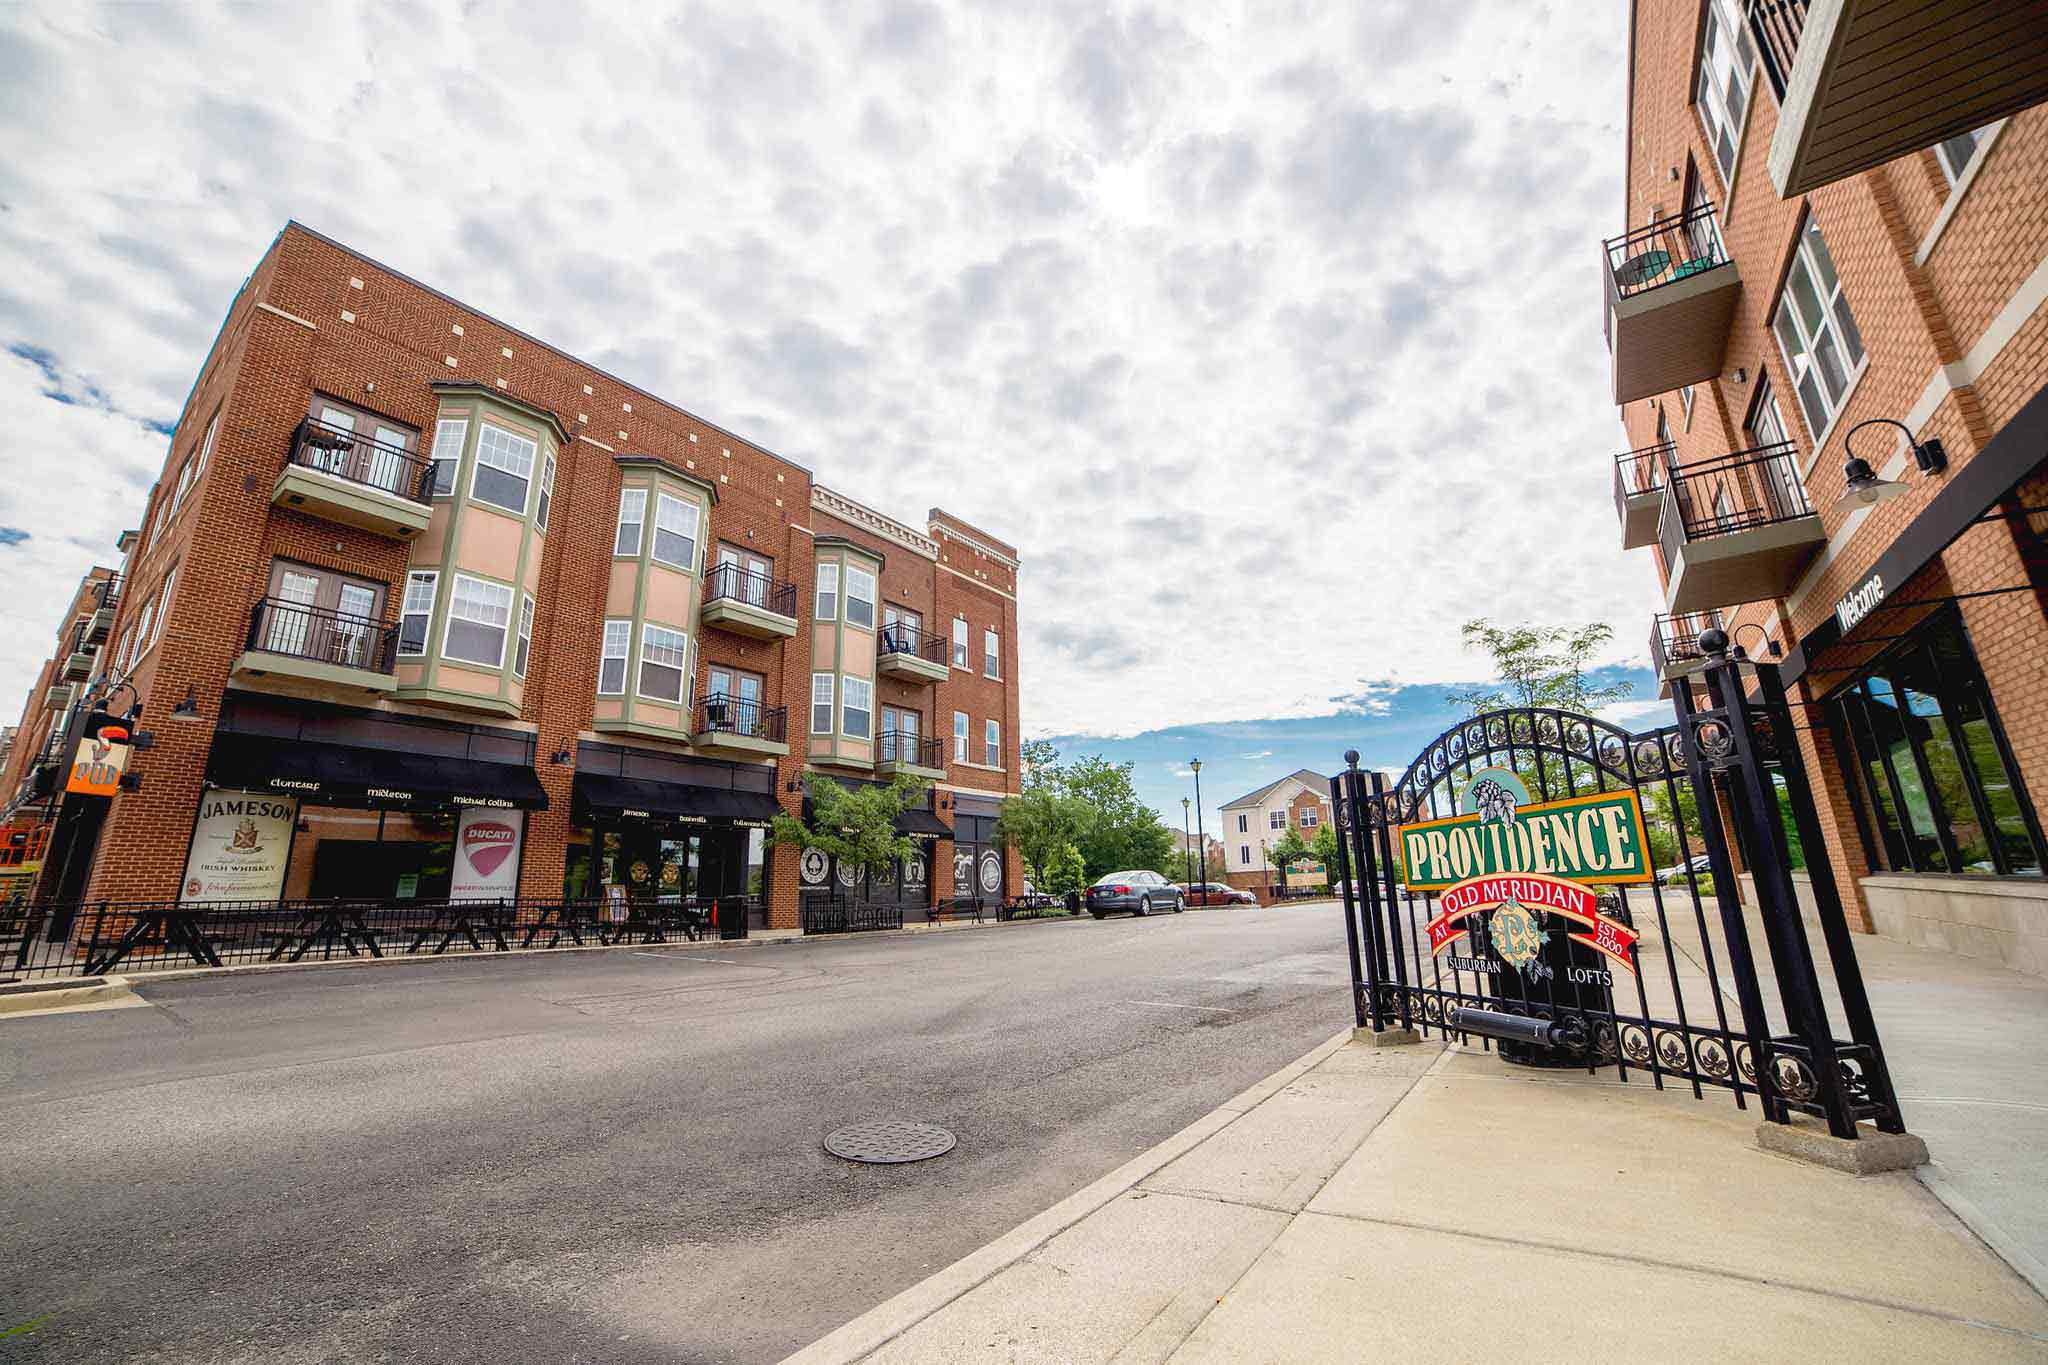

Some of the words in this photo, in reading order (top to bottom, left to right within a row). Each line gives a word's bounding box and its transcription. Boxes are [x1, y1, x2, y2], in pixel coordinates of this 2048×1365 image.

[1836, 574, 1884, 631] Welcome
[76, 762, 118, 785] PUB
[203, 800, 294, 822] JAMESON
[467, 829, 514, 840] DUCATI
[1406, 805, 1636, 881] PROVIDENCE
[200, 863, 228, 873] IRISH
[231, 863, 275, 873] WHISKEY
[1445, 885, 1479, 913] OLD
[1484, 879, 1584, 913] MERIDIAN
[1435, 922, 1448, 943] AT
[1597, 922, 1617, 941] EST.
[1596, 932, 1623, 955] 2000
[1449, 957, 1501, 974] SUBURBAN
[1567, 967, 1612, 986] LOFTS
